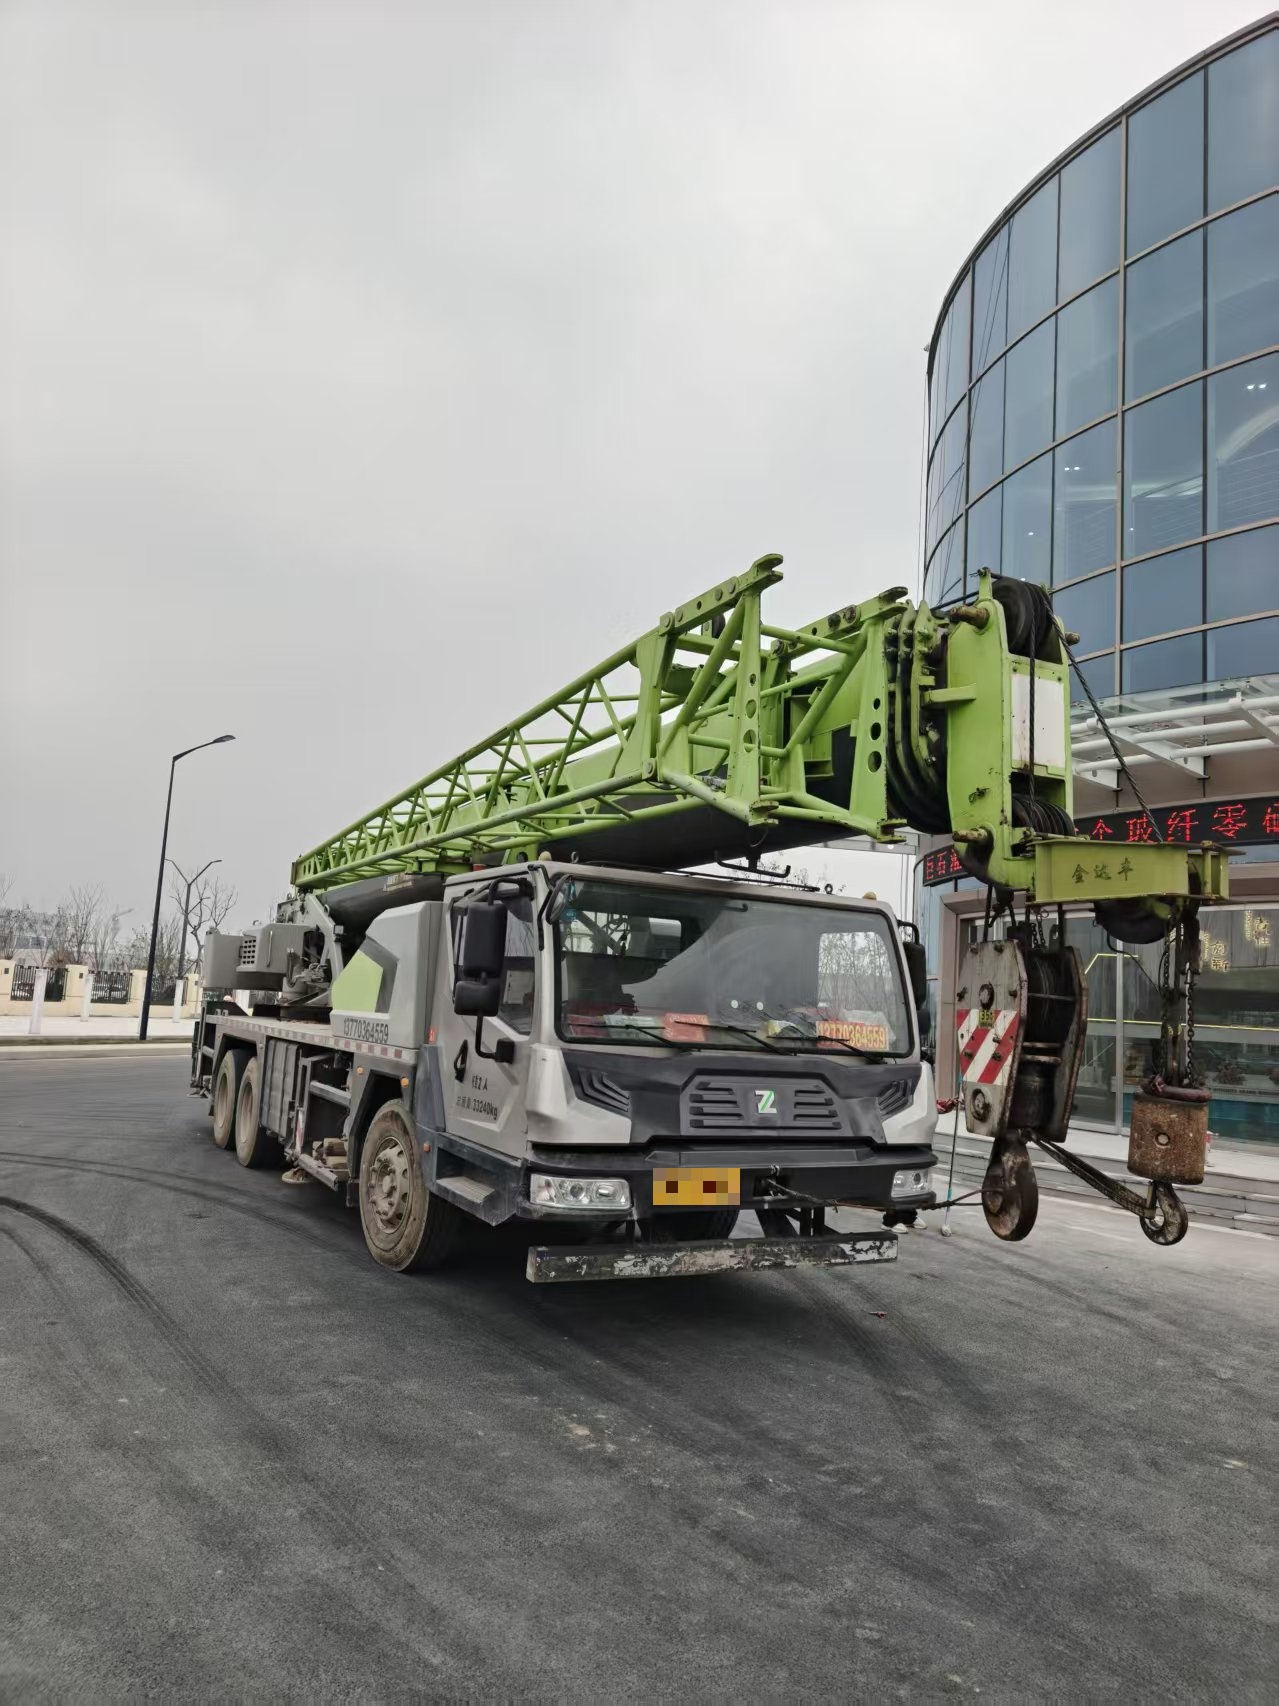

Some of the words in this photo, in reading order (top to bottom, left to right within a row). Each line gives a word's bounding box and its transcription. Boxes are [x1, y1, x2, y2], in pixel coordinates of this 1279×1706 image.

[1075, 803, 1279, 843] 个玻纤零
[343, 1017, 389, 1044] 13770364559
